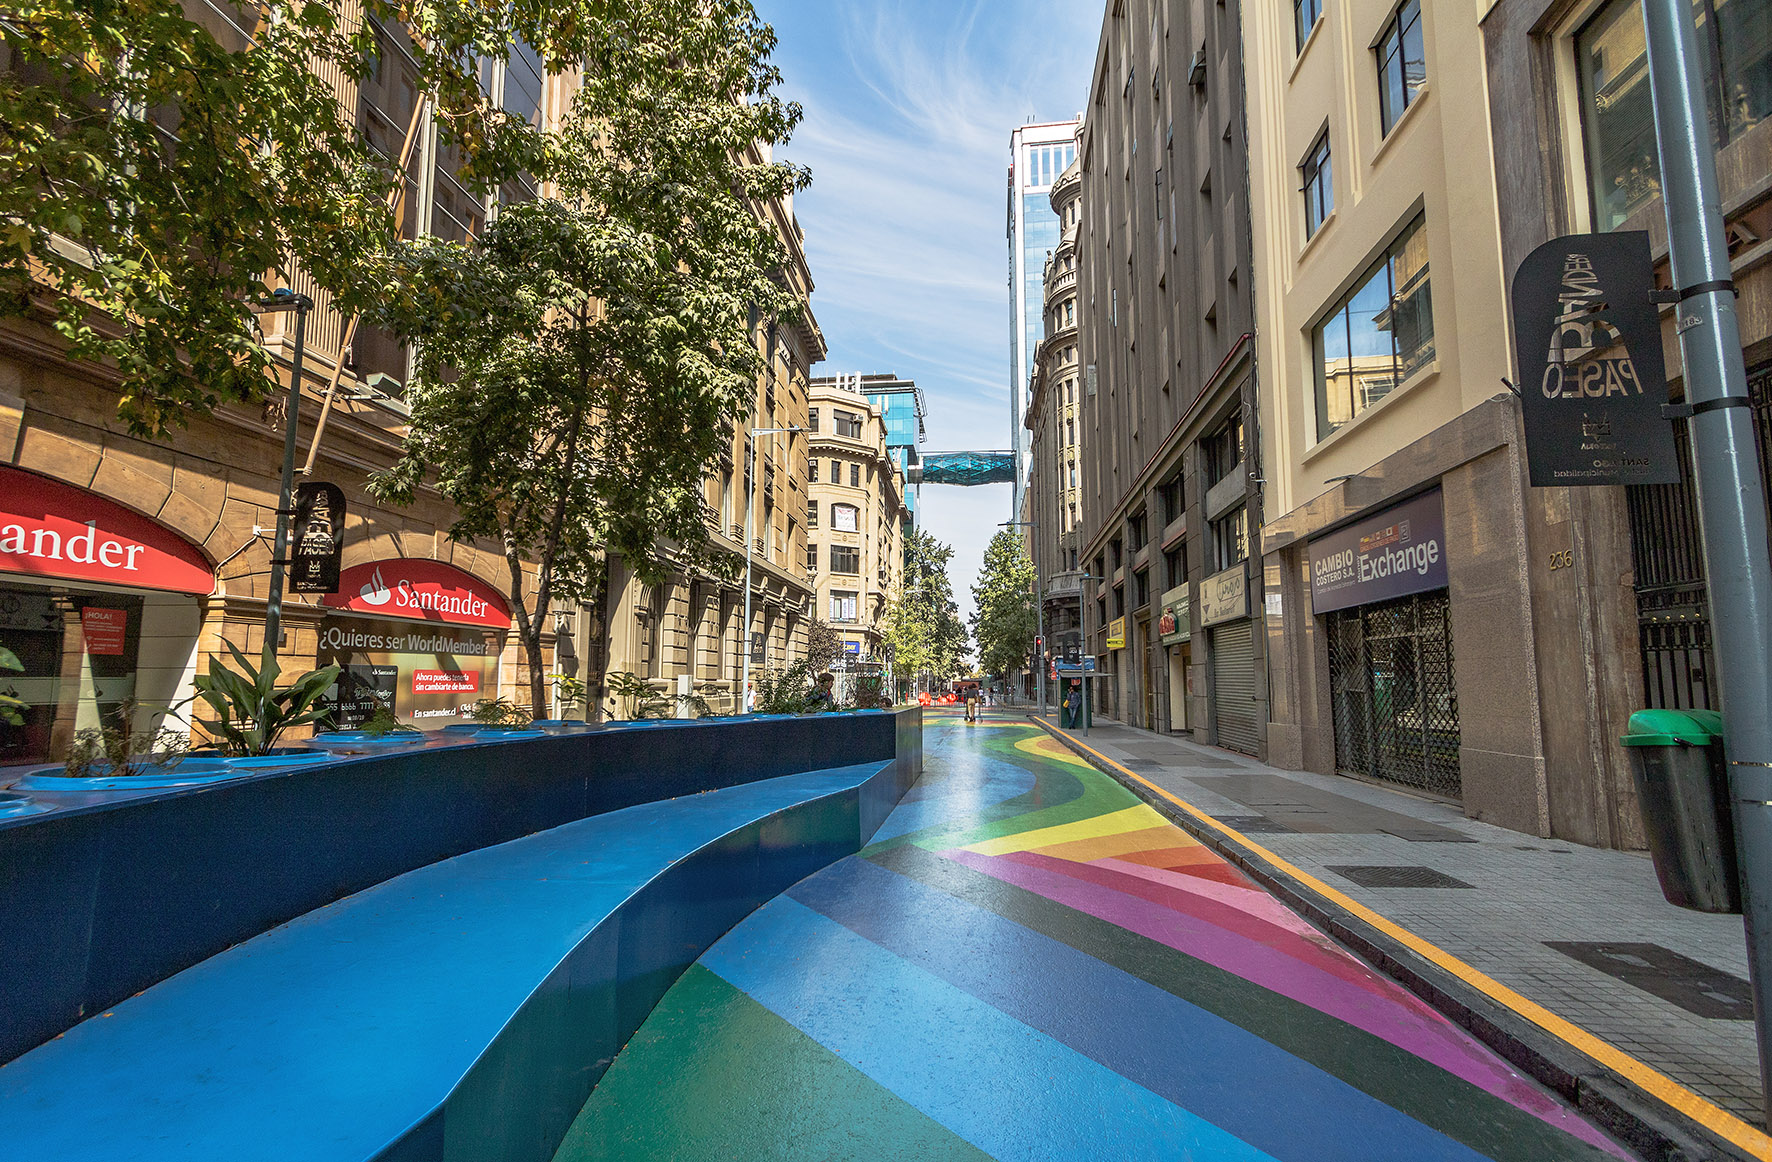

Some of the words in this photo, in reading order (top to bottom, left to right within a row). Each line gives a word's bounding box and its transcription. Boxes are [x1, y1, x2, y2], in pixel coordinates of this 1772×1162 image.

[1315, 549, 1353, 577] CAMBIO
[1360, 539, 1439, 582] Exchange
[1549, 549, 1573, 570] 236
[1316, 570, 1341, 587] COSTERO
[1342, 567, 1355, 579] S.A.
[396, 579, 488, 617] Santander
[320, 627, 383, 650] ¿Quieres
[386, 635, 405, 649] ser
[408, 633, 490, 655] WorldMember?
[416, 673, 432, 681] Ahora
[433, 674, 451, 683] puedes
[416, 683, 424, 691] sin
[425, 683, 451, 691] cambiarte
[414, 710, 422, 718] En
[423, 707, 456, 717] santander.cl
